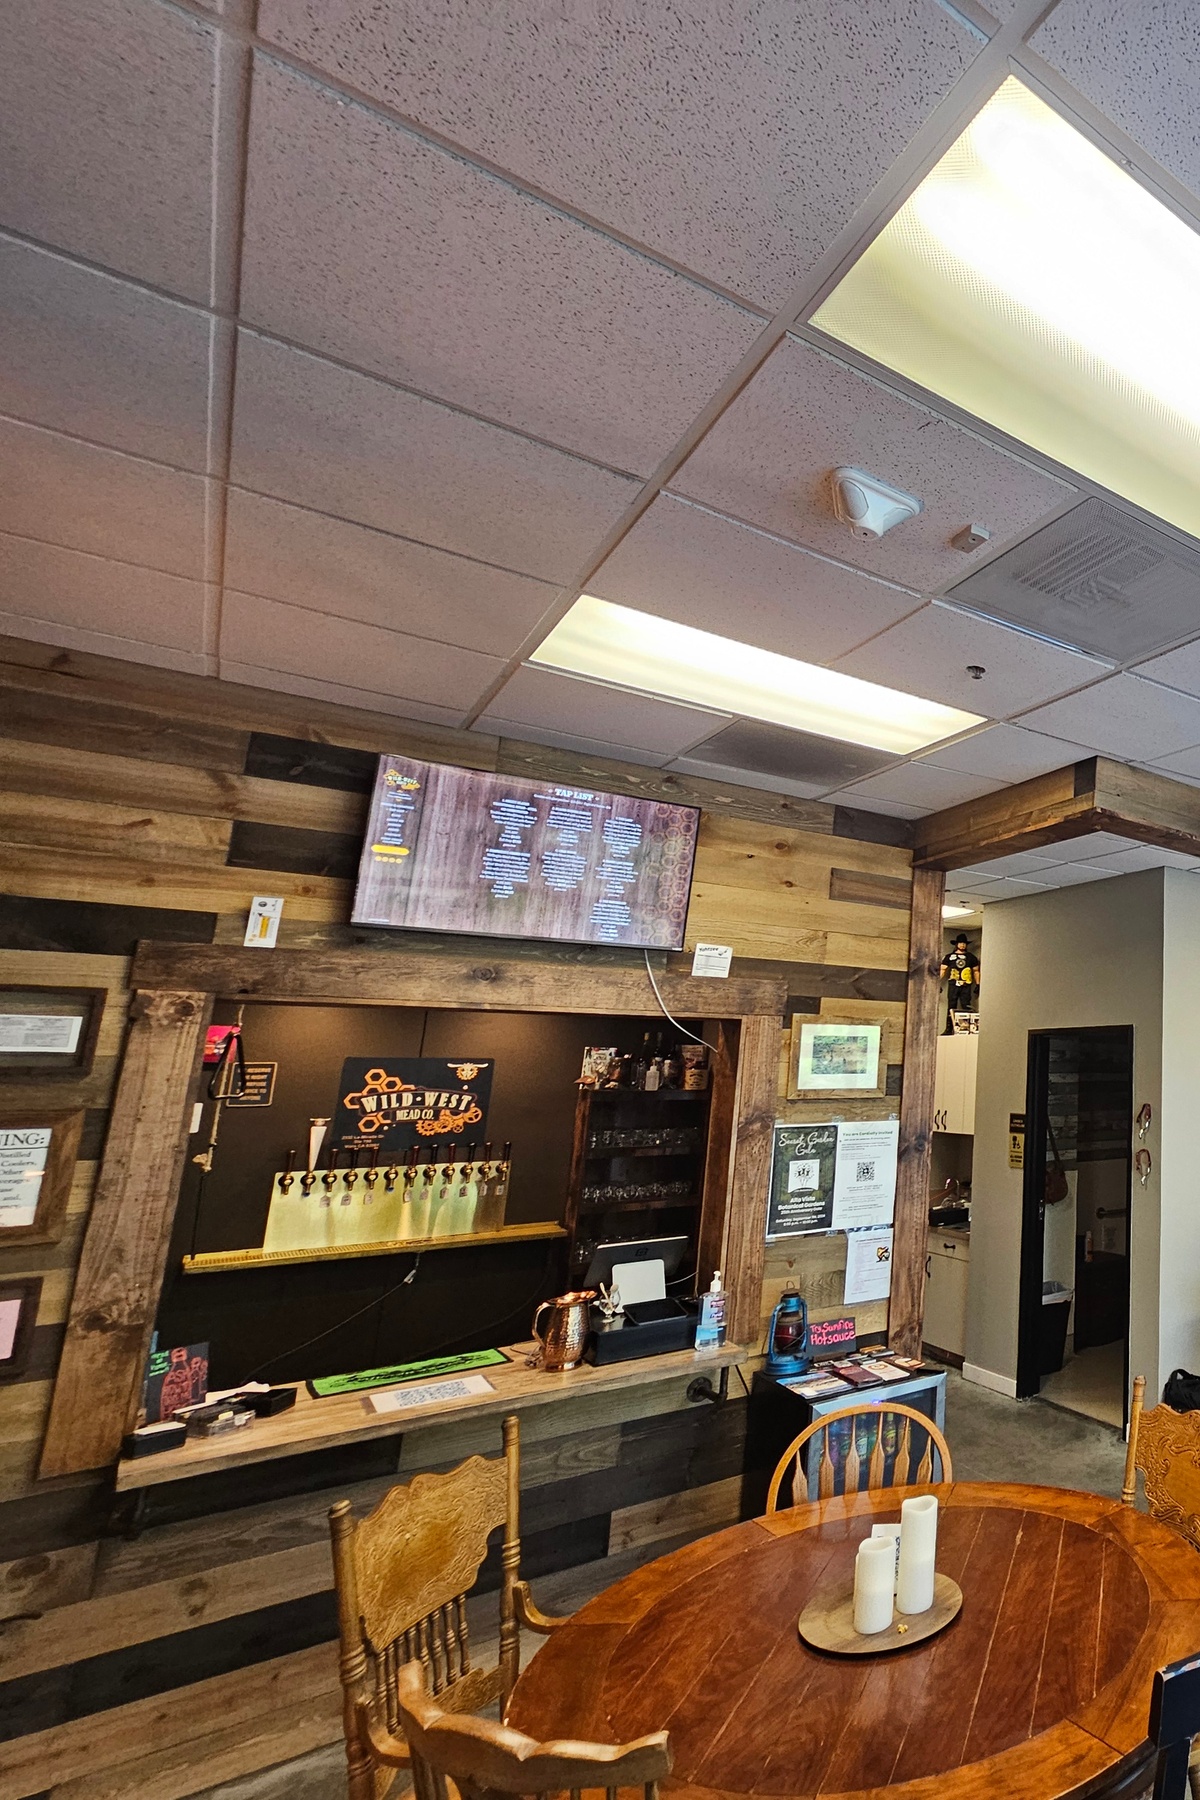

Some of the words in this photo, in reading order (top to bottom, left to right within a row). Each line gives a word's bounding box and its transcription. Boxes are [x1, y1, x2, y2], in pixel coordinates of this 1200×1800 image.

[555, 788, 573, 797] TAP
[574, 791, 594, 801] LIST
[361, 1092, 413, 1113] WILD
[424, 1091, 473, 1111] WEST
[396, 1109, 421, 1121] MEAD
[421, 1109, 434, 1120] CO.
